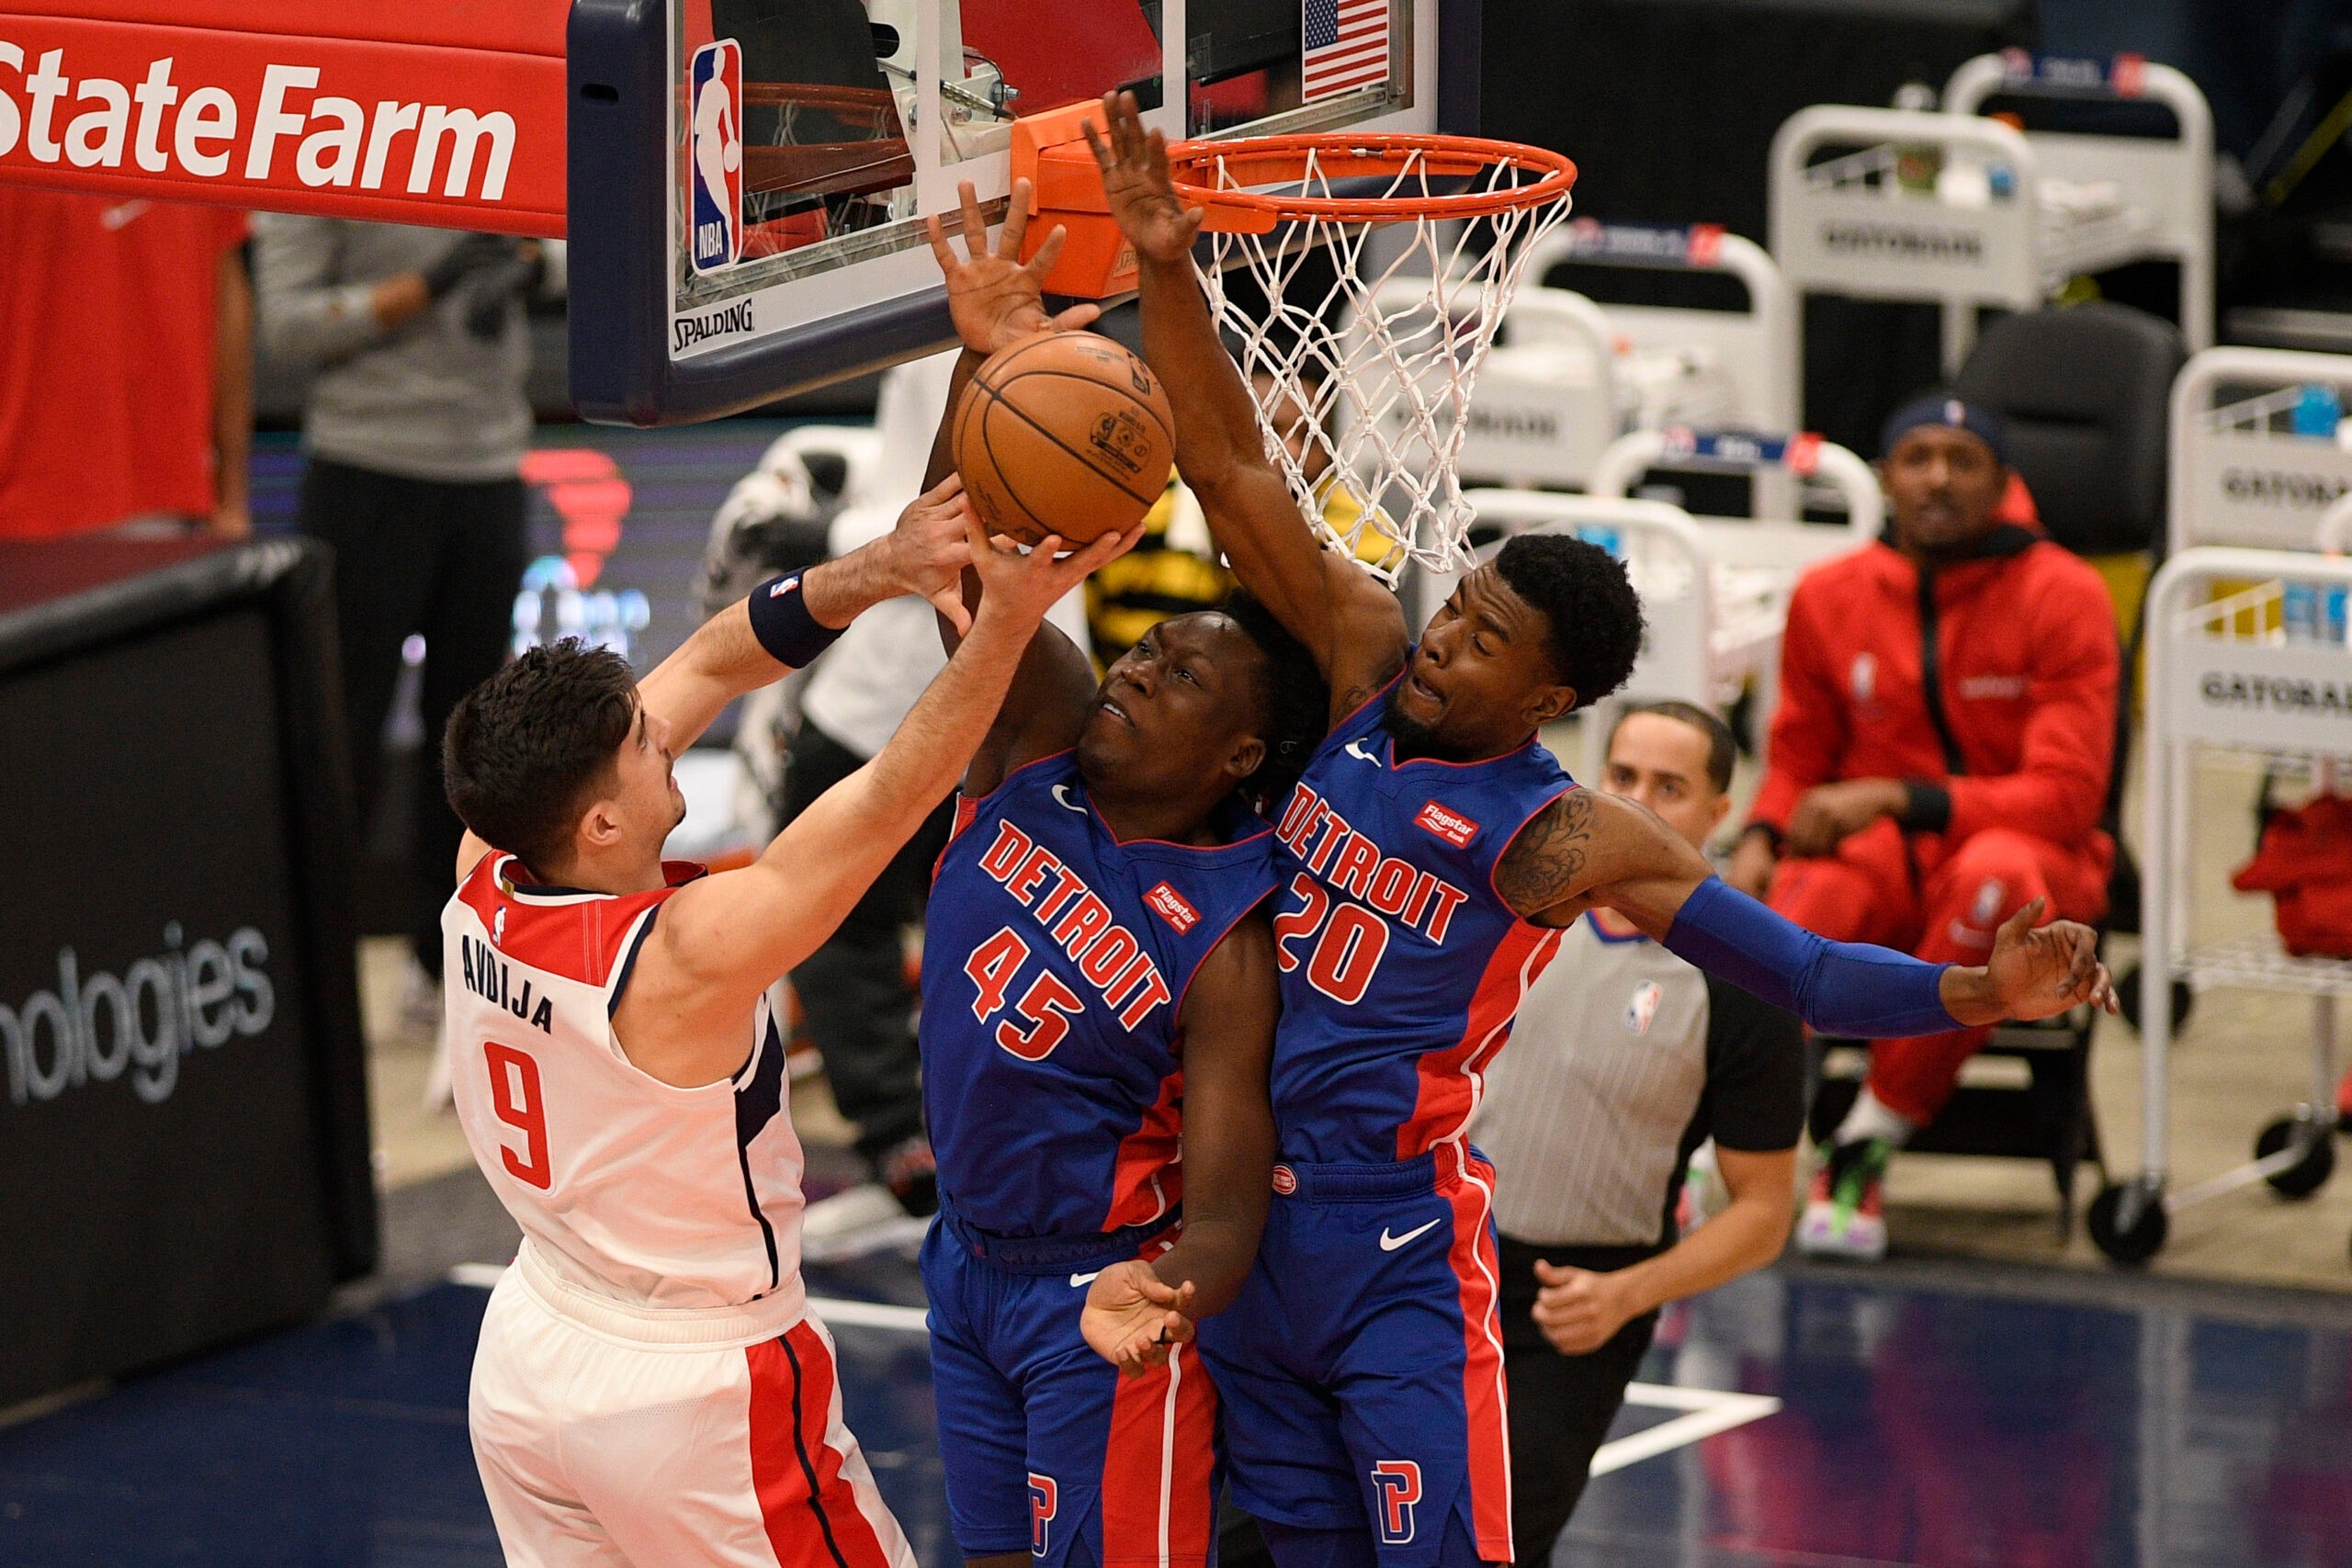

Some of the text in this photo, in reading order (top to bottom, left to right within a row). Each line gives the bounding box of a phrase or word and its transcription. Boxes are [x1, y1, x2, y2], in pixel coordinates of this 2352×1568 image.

[698, 220, 723, 260] NBA
[674, 299, 753, 353] SPALDING
[1275, 782, 1469, 946] DETROIT
[1424, 805, 1474, 835] Flagstar
[978, 818, 1171, 1032] DETROIT
[1155, 886, 1196, 924] Flagstar
[1273, 872, 1390, 1006] 20
[461, 935, 553, 1035] AVDIJA
[963, 925, 1086, 1062] 45
[483, 1040, 555, 1193] 9
